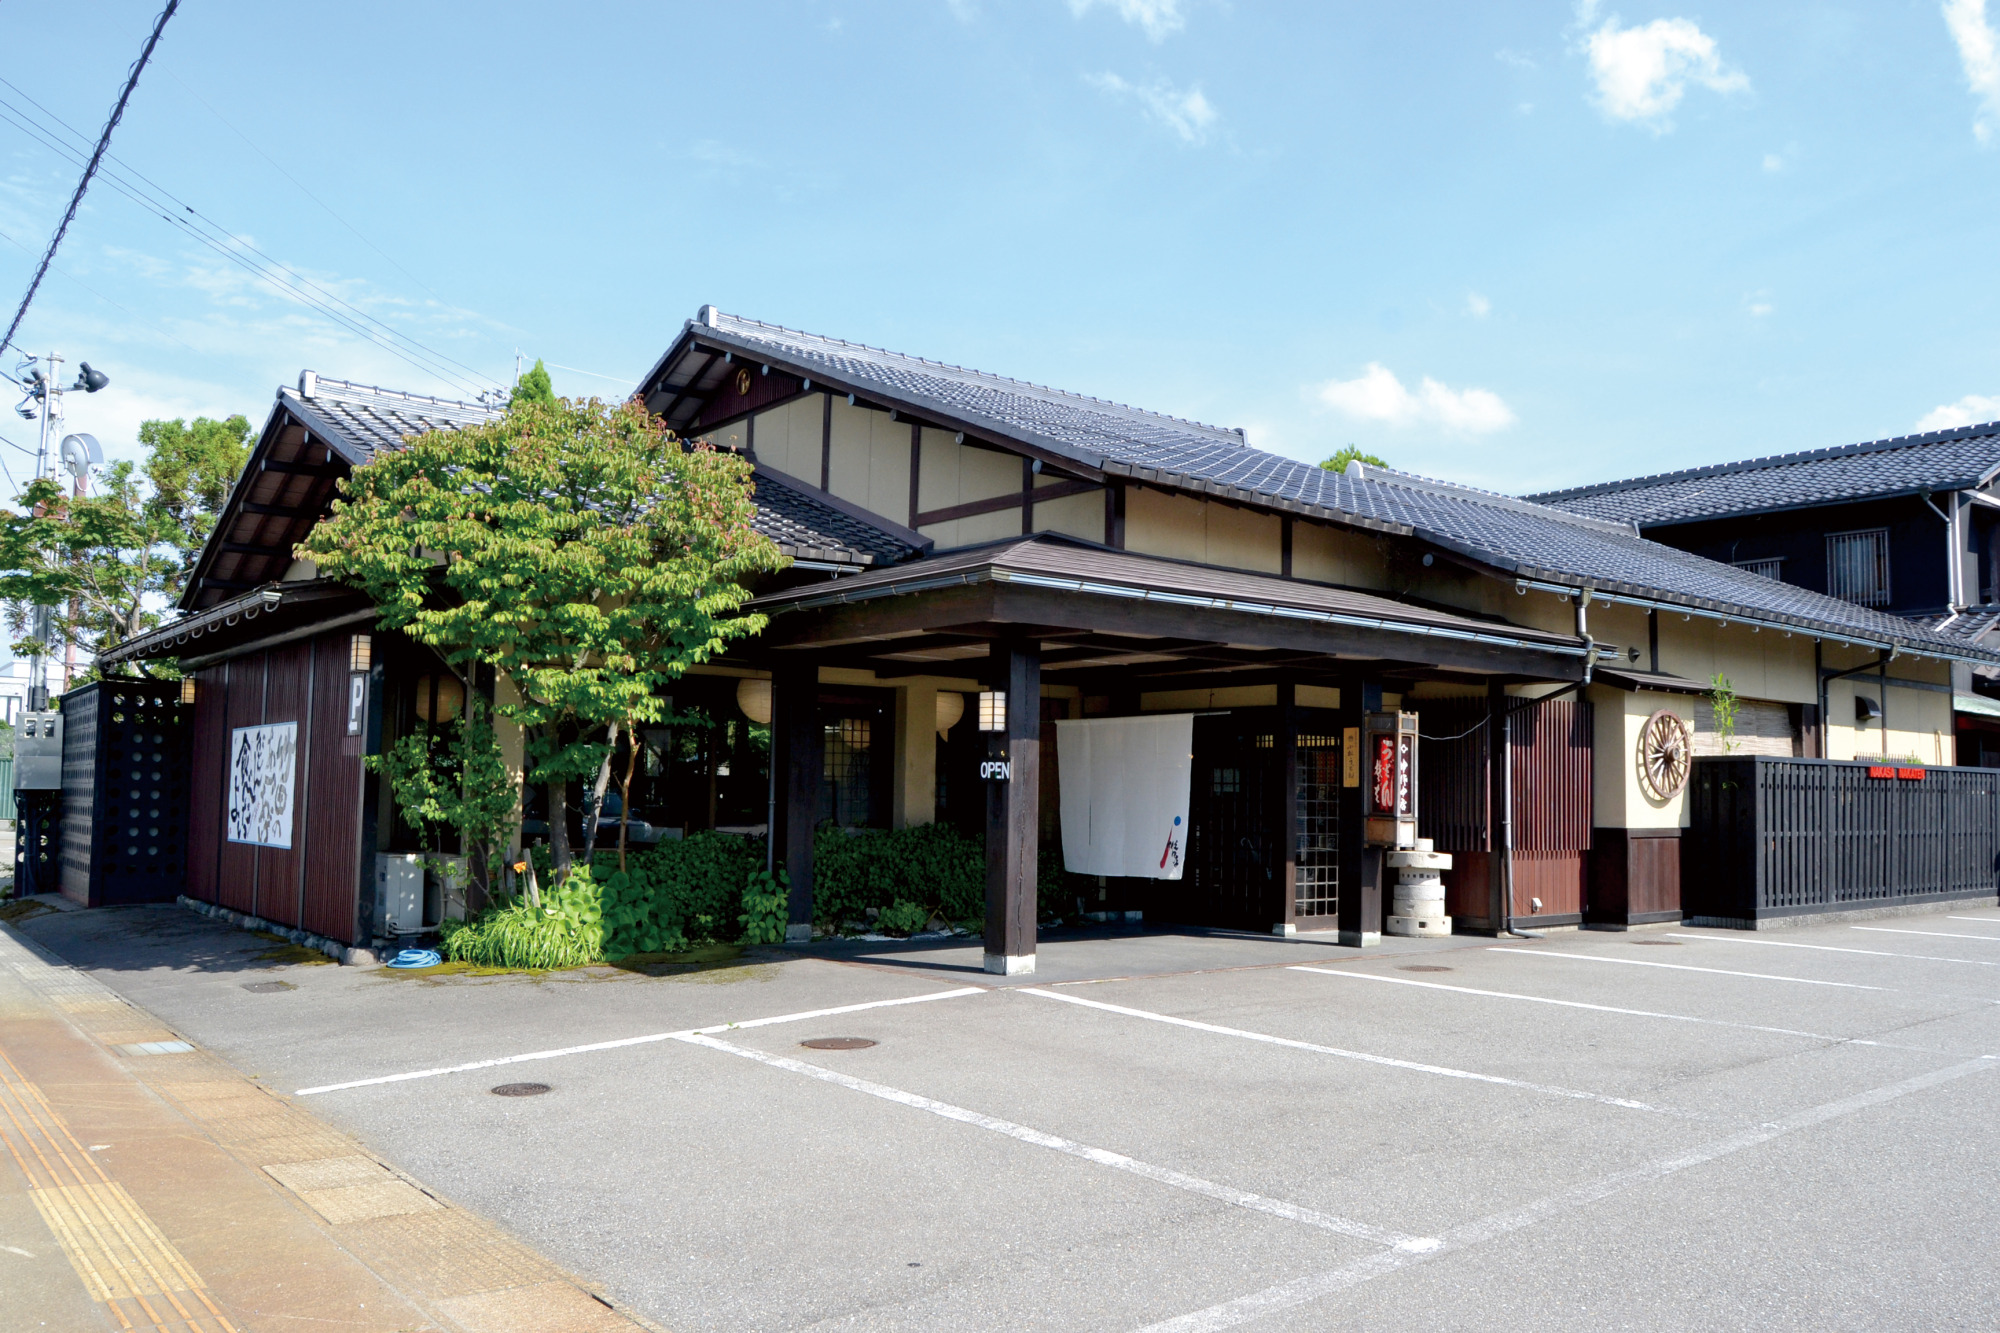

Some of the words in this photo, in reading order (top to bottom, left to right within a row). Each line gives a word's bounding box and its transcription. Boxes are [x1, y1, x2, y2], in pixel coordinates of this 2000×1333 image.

[351, 677, 363, 719] P
[980, 761, 1010, 779] OPEN
[1382, 739, 1394, 807] うどん
